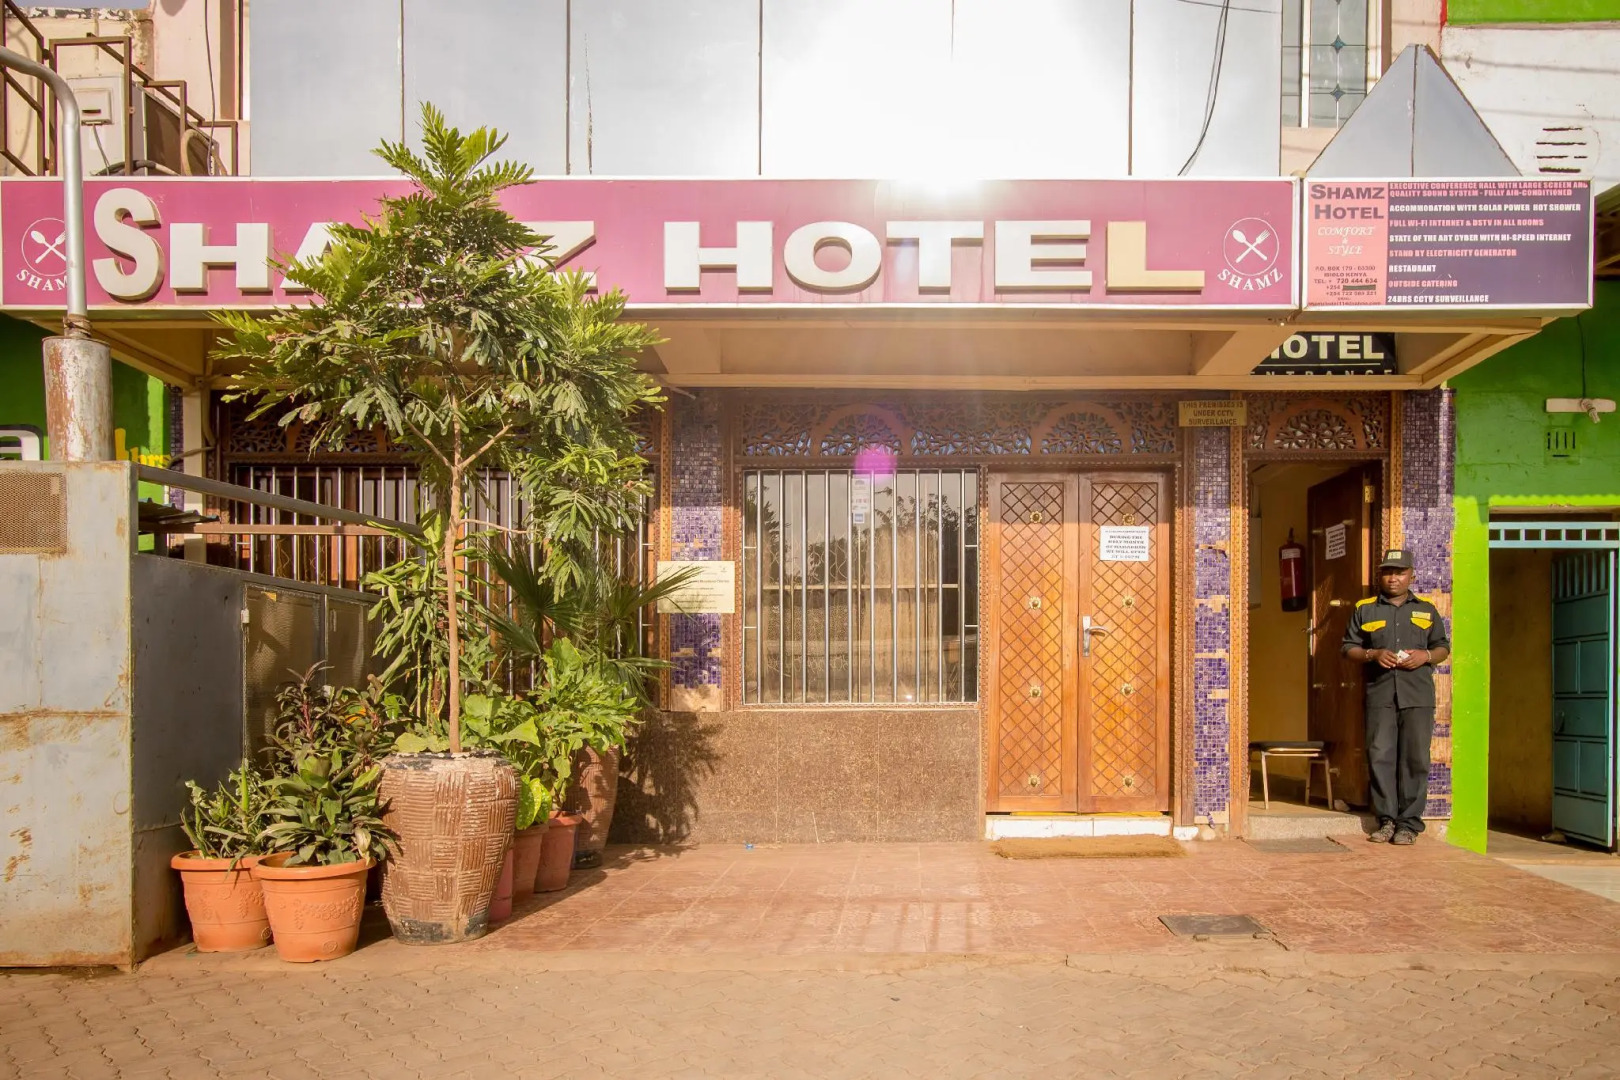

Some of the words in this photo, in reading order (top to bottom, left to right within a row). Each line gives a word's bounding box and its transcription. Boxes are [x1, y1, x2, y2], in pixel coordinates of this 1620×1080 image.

[1389, 182, 1430, 190] EXECUTIVE
[1430, 182, 1478, 190] CONFERENCE
[1497, 181, 1518, 189] WITH
[1519, 181, 1543, 189] LARGE
[1543, 181, 1572, 189] SCREEN
[1310, 184, 1385, 200] SHAMZ
[1422, 189, 1448, 197] SOUND
[1449, 189, 1479, 197] SYSTEM
[1484, 189, 1505, 197] FULLY
[1505, 189, 1573, 197] AIR-CONDITIONED
[1314, 204, 1384, 220] HOTEL
[1389, 204, 1456, 212] ACCOMMODATION
[1456, 204, 1478, 212] WITH
[1478, 204, 1503, 212] SOLAR
[1549, 203, 1581, 211] SHOWER
[1407, 219, 1428, 227] WI-FI
[1429, 219, 1464, 227] INTERNET
[1317, 226, 1376, 237] COMFORT
[1389, 234, 1412, 242] STATE
[1412, 234, 1422, 242] OF
[1423, 234, 1437, 242] THE
[1536, 233, 1572, 241] INTERNET
[92, 187, 598, 299] SHAZ
[663, 219, 1206, 294] HOTEL
[1327, 245, 1363, 257] STYLE
[1389, 249, 1414, 257] STAND
[1414, 249, 1425, 257] BY
[1426, 249, 1473, 257] ELECTRICITY
[1473, 249, 1517, 257] GENERATOR
[1388, 264, 1437, 273] RESTAURANT
[16, 269, 68, 291] SHAM
[1217, 267, 1283, 291] SHAMZ
[1388, 280, 1420, 288] OUTSIDE
[1421, 280, 1458, 288] CATERING
[1387, 295, 1412, 303] 24HRS
[1413, 295, 1434, 303] CCTV
[1434, 294, 1489, 303] SURVEILLANCE
[1270, 334, 1385, 360] OTEL
[1183, 401, 1198, 409] THIS
[1193, 409, 1216, 417] UNDER
[1216, 409, 1234, 417] CCTV
[1188, 418, 1237, 426] SURVEILLANCE
